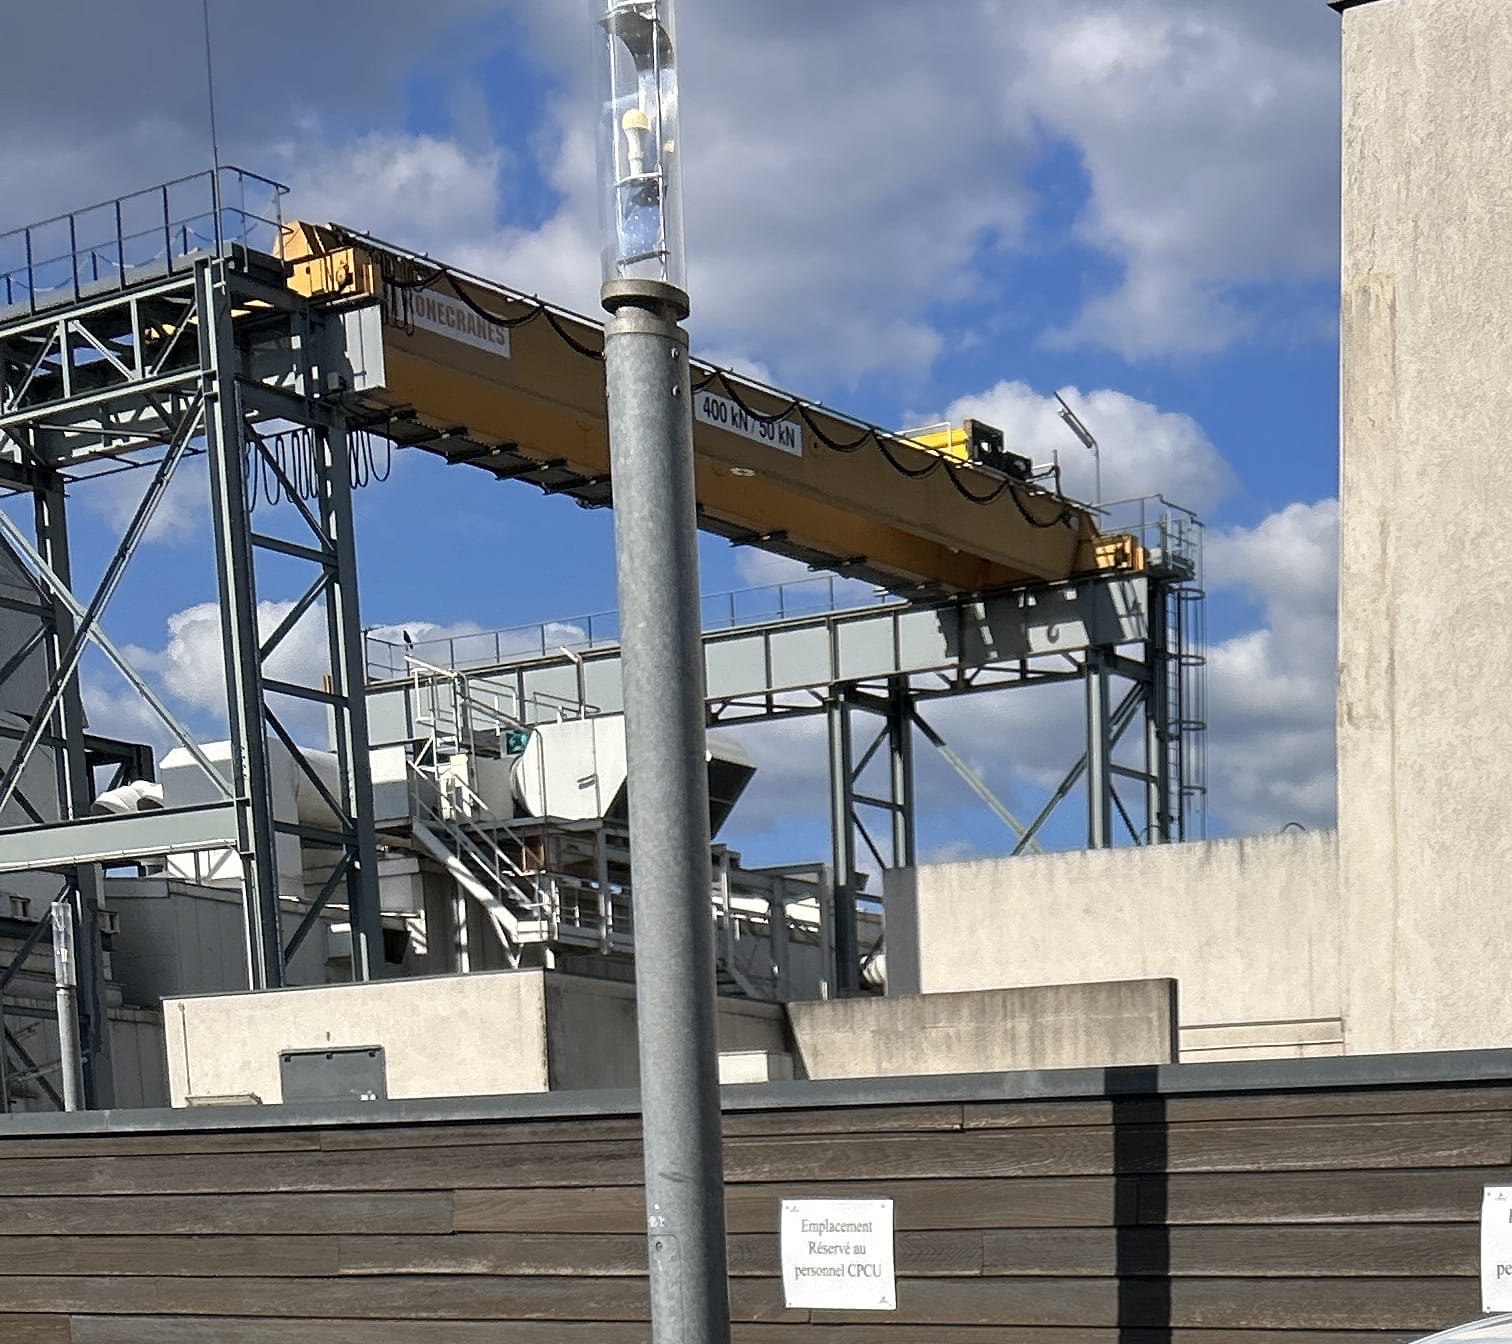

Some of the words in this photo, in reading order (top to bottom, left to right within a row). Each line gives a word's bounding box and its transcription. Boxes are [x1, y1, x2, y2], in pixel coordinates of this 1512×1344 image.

[703, 396, 728, 424] 400
[731, 405, 748, 433] kN
[760, 420, 775, 441] 50
[778, 422, 795, 448] kN
[801, 1218, 873, 1237] Emplacement
[808, 1241, 851, 1255] Réservé
[853, 1244, 867, 1255] au
[795, 1264, 845, 1280] personnel
[847, 1263, 882, 1278] CPCU
